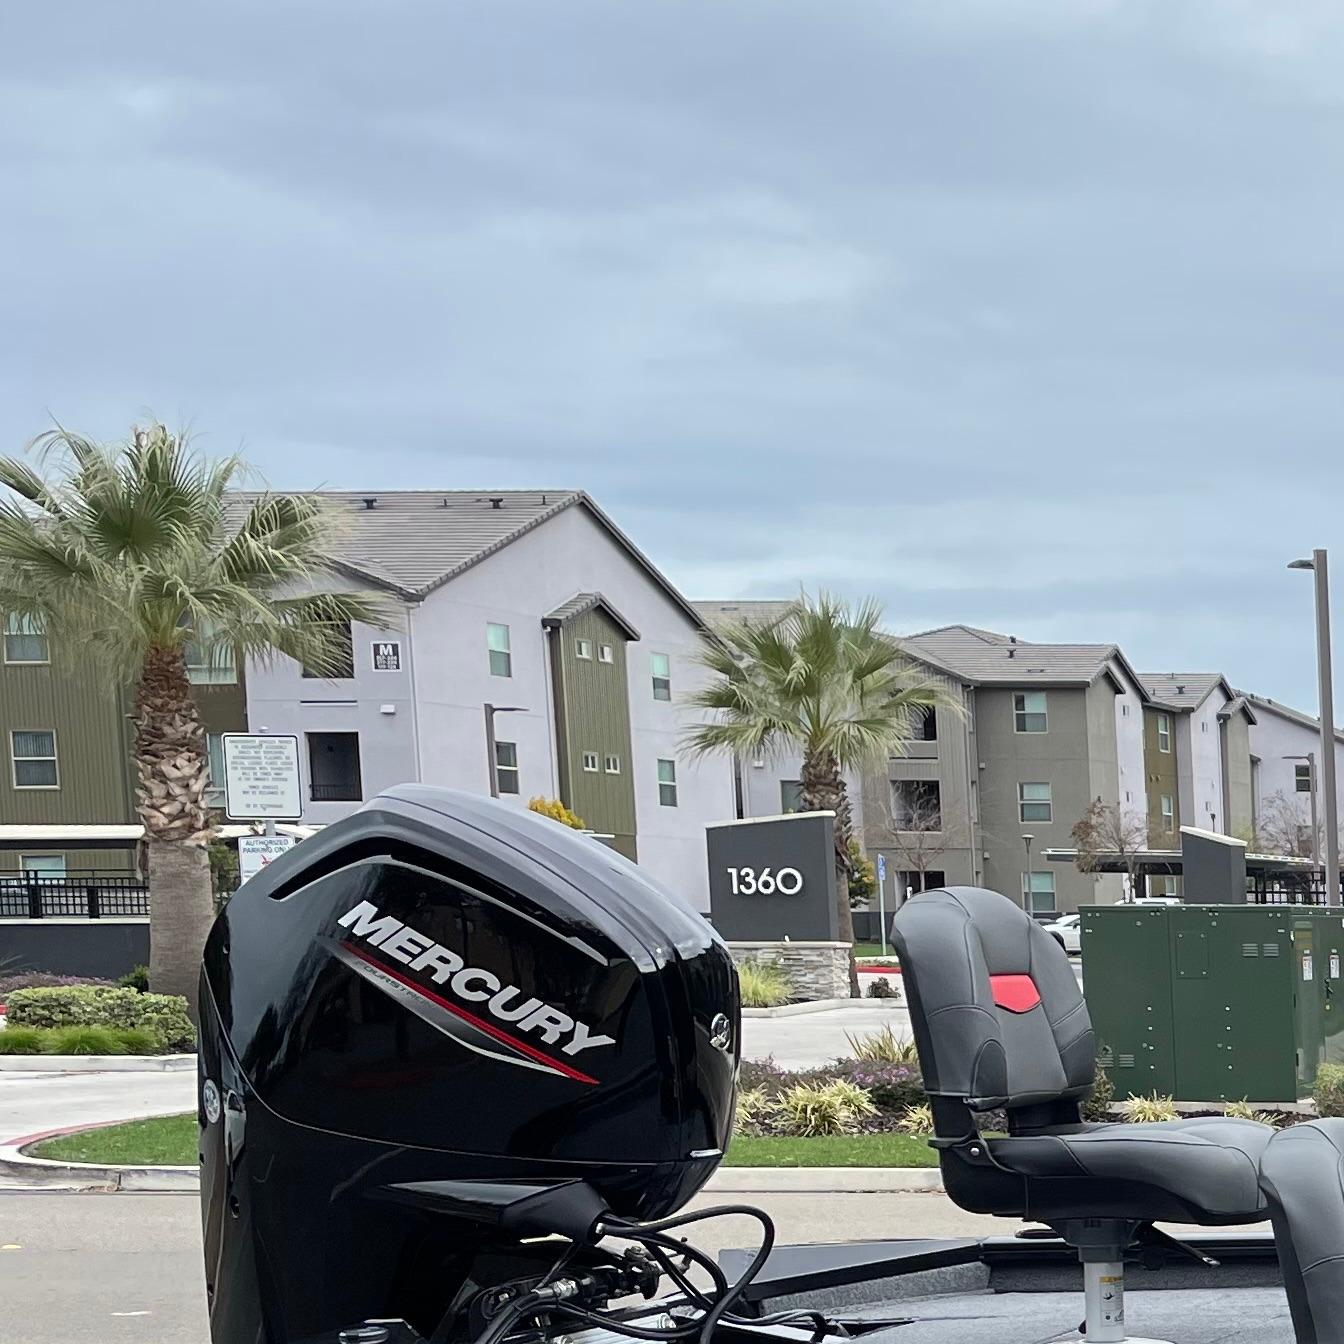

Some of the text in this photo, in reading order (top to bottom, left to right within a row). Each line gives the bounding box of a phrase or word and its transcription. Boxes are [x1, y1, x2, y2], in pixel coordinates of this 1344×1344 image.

[380, 644, 393, 656] M
[727, 867, 803, 895] 1360
[337, 900, 616, 1056] MERCURY
